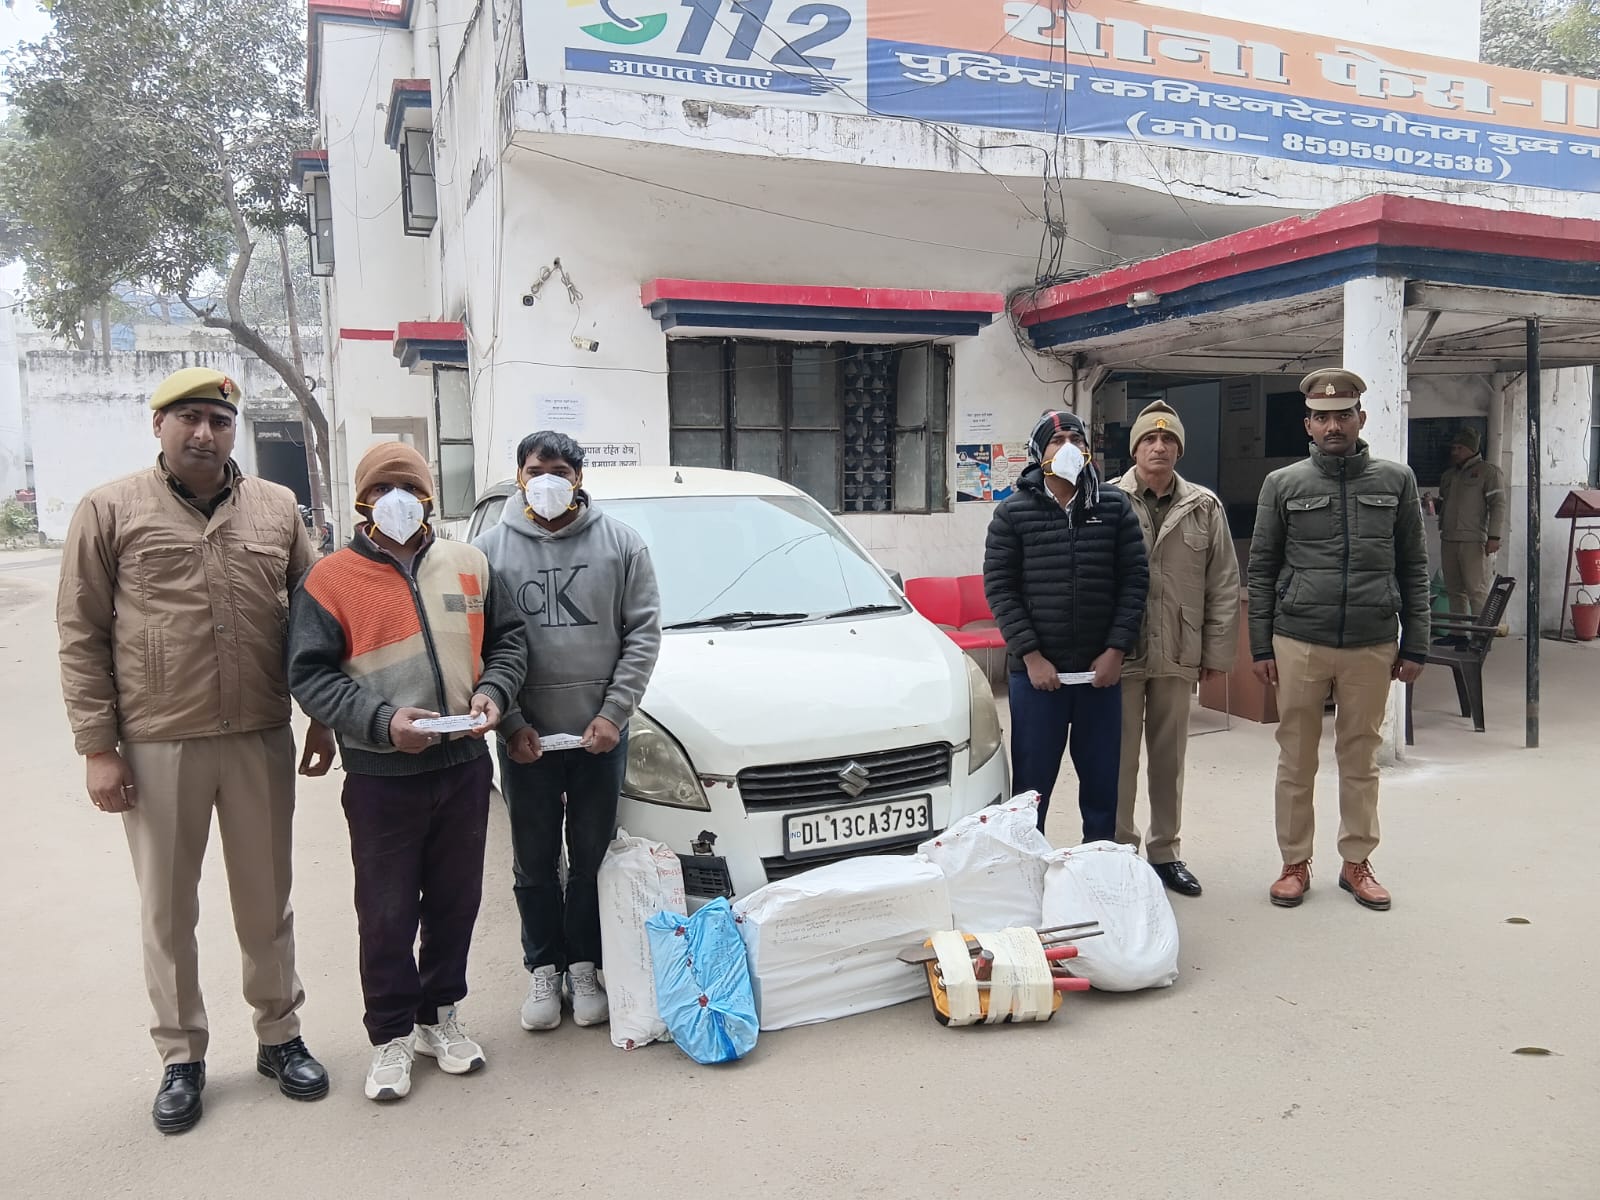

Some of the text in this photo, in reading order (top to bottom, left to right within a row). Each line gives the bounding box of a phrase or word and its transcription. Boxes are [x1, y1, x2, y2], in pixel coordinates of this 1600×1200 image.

[676, 0, 852, 70] 112
[1002, 2, 1290, 85] थाना
[609, 59, 773, 90] आपात सेवाएं
[894, 52, 1080, 91] पुलिस
[1089, 79, 1347, 126] कमिश्नरेट
[1350, 112, 1480, 143] गौतम
[1282, 133, 1512, 180] 8595902538)
[802, 805, 927, 845] DL13CA3793
